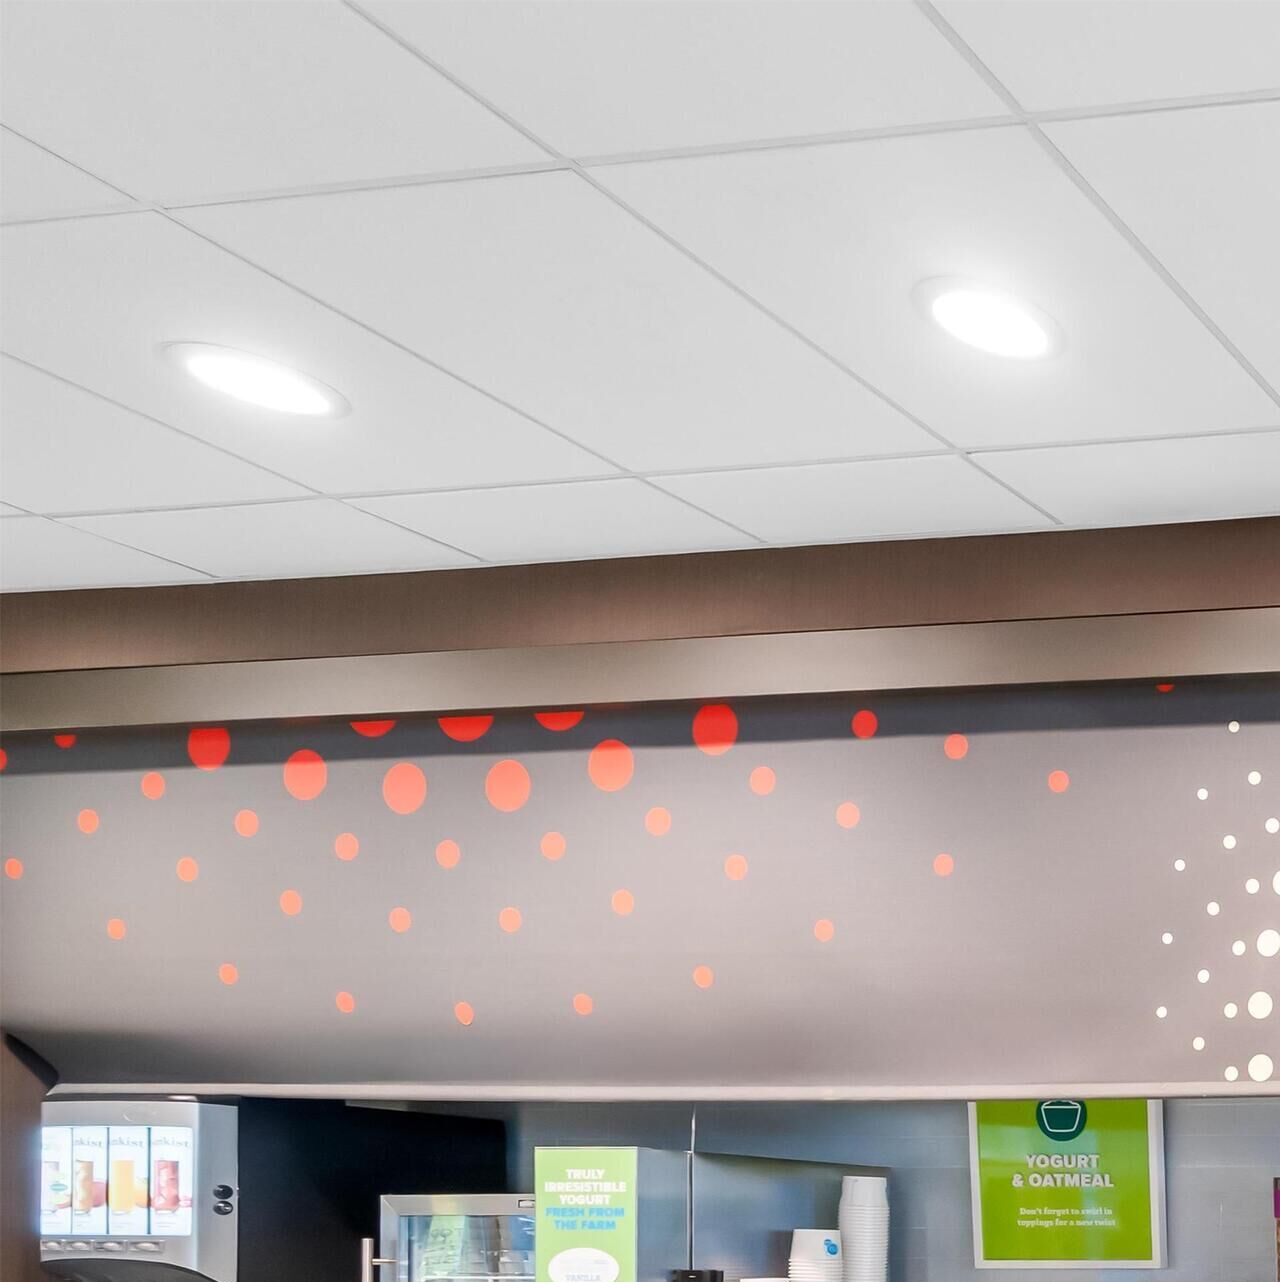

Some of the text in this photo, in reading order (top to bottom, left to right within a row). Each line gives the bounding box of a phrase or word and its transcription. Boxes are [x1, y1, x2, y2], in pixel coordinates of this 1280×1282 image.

[1026, 1154, 1100, 1169] YOGURT
[565, 1168, 605, 1179] TRULY
[1012, 1173, 1114, 1187] & OATMEAL
[544, 1181, 627, 1192] IRRESISTIBLE
[559, 1194, 612, 1205] YOGURT
[545, 1207, 625, 1217] FRESH FROM
[1020, 1207, 1042, 1215] Don't
[1043, 1207, 1069, 1217] forget
[555, 1220, 617, 1230] THE FARM
[1055, 1218, 1068, 1226] for
